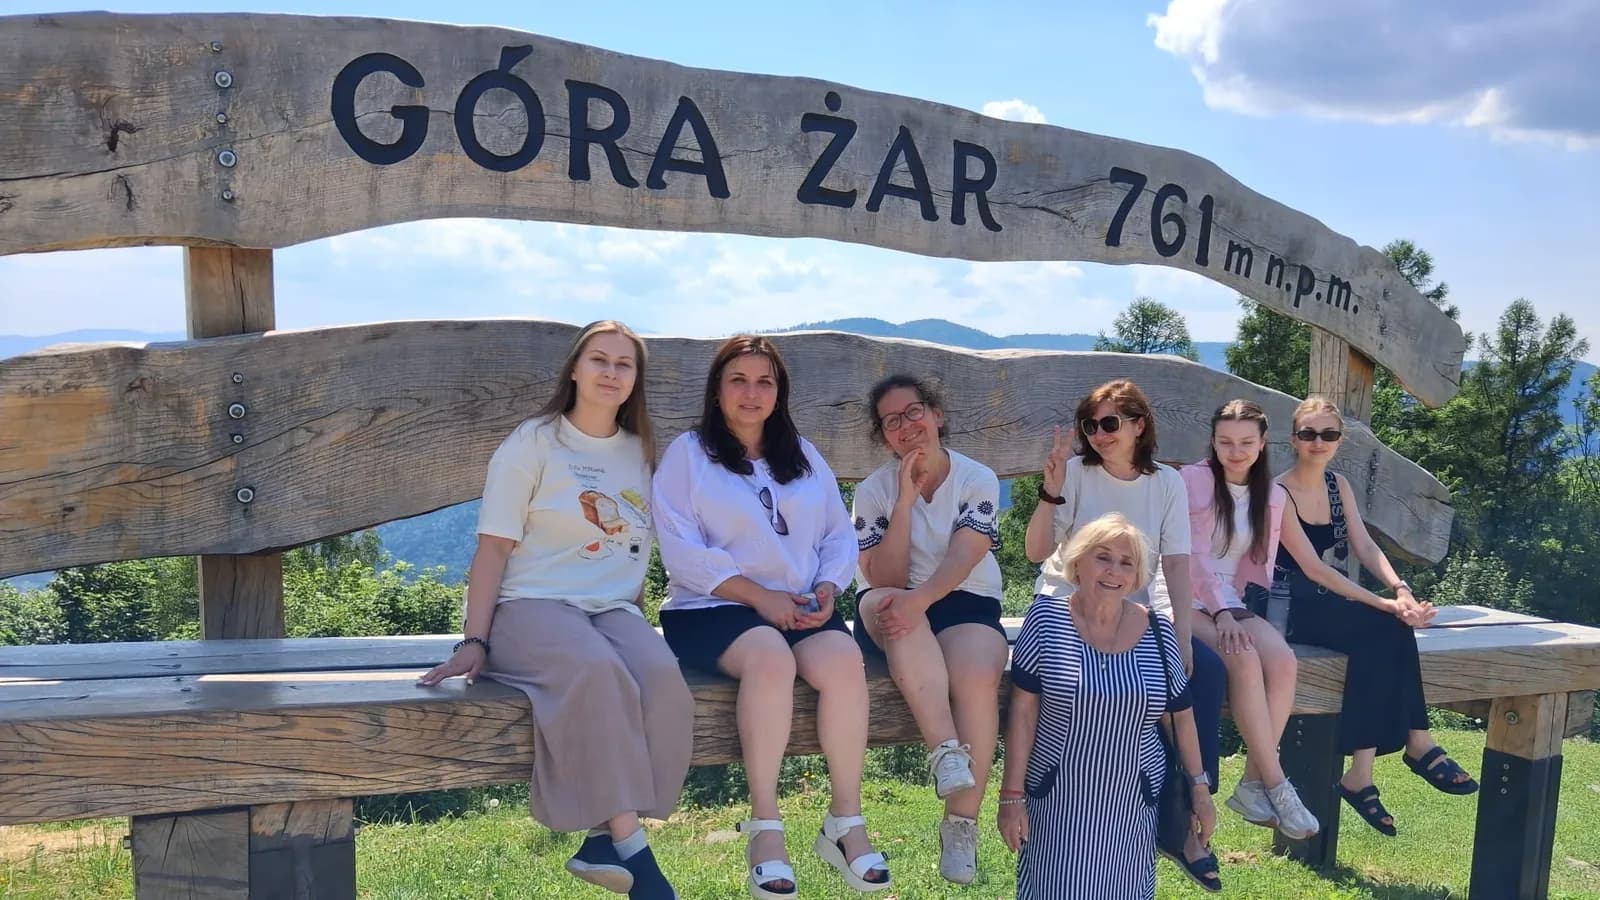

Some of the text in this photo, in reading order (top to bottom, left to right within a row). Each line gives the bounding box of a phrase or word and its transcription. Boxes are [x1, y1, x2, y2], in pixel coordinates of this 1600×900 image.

[331, 44, 1359, 314] GÓRA ŻAR 761 m n.p.m.
